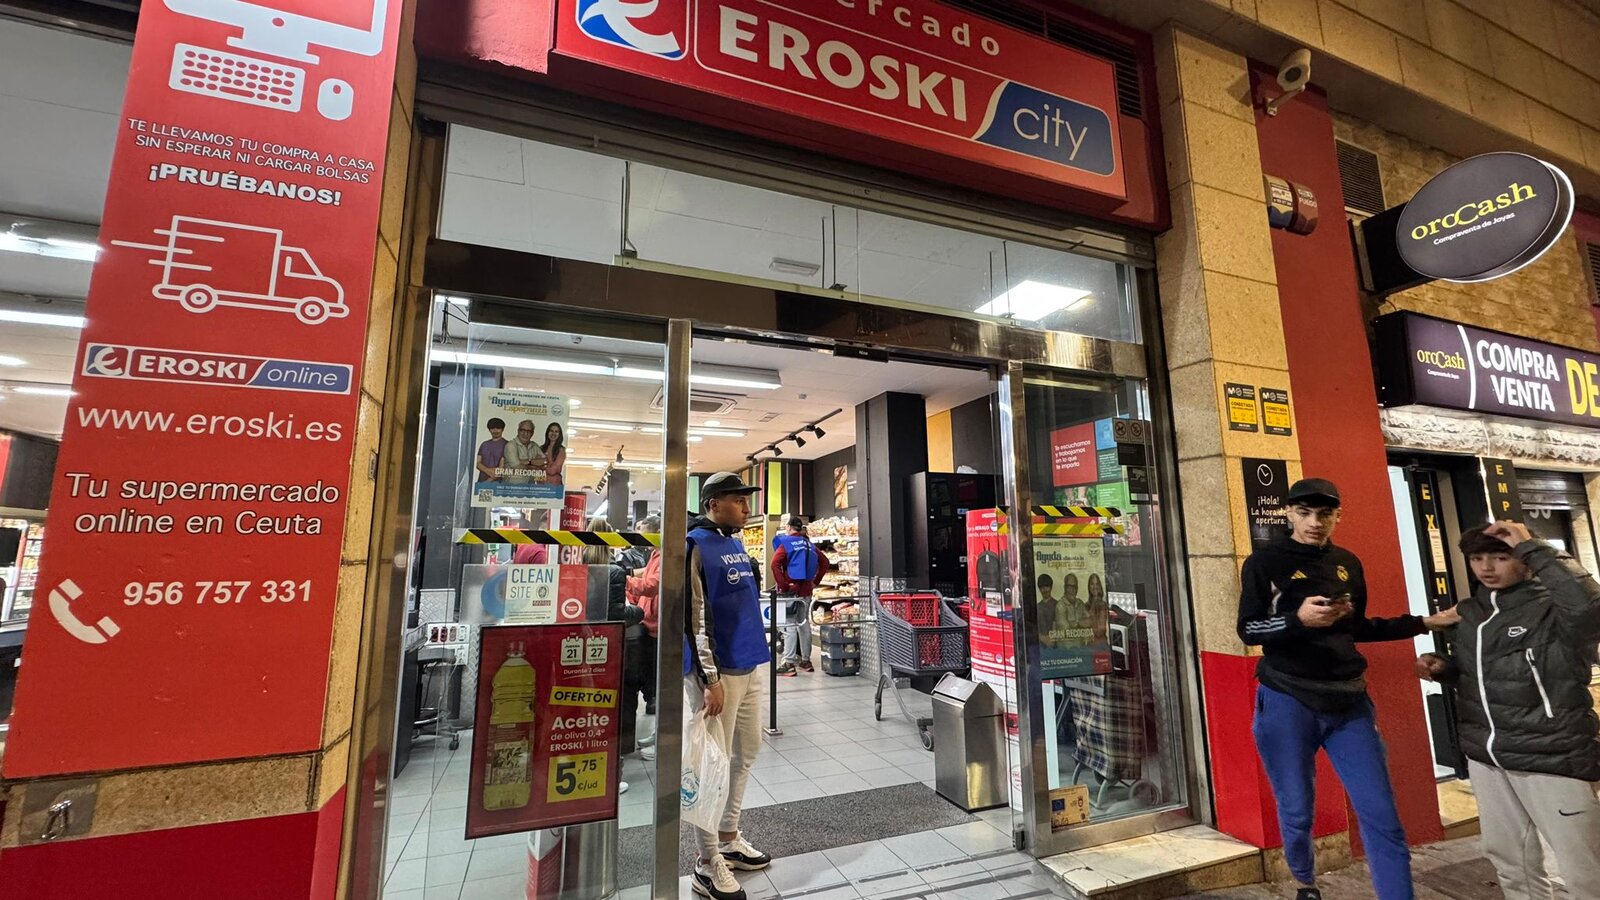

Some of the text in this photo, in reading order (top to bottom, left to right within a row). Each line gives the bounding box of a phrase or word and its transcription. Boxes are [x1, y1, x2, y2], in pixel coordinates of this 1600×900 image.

[719, 6, 968, 122] EROSKI
[1013, 105, 1088, 161] city
[127, 118, 375, 172] TE LLEVAMOS TU COMPRA A CASA
[135, 134, 370, 184] SIN ESPERAR NI CARGAR BOLSAS
[148, 162, 342, 206] ¡PRUÉBANOS!
[1411, 182, 1537, 240] oroCash
[1433, 212, 1516, 245] Compraventa de Joyas
[1416, 349, 1466, 370] oroCash
[138, 355, 338, 386] EROSKI online
[1476, 339, 1600, 418] COMPRA DE
[491, 396, 521, 407] Ayuda
[1490, 374, 1556, 412] VENTA
[78, 406, 342, 442] www.eroski.es
[1059, 447, 1086, 457] trabajamos
[1060, 440, 1091, 450] escuchamos
[495, 468, 547, 478] GRAN RECOGIDA
[1061, 461, 1080, 469] importa
[65, 473, 340, 504] Tu supermercado
[1495, 464, 1514, 524] EMP
[1257, 495, 1280, 505] ¡Hola!
[75, 508, 322, 535] online en Ceuta
[1250, 507, 1260, 516] La
[1261, 507, 1276, 516] hora
[1255, 517, 1287, 526] apertura:
[511, 568, 554, 583] CLEAN
[123, 579, 312, 606] 956 757 331
[510, 585, 531, 599] SITE
[566, 648, 604, 659] 21 27
[554, 689, 612, 703] OFERTÓN
[551, 712, 610, 731] Aceite
[550, 741, 584, 752] EROSKI,
[591, 739, 609, 748] litro
[551, 733, 563, 741] de
[564, 731, 586, 740] oliva
